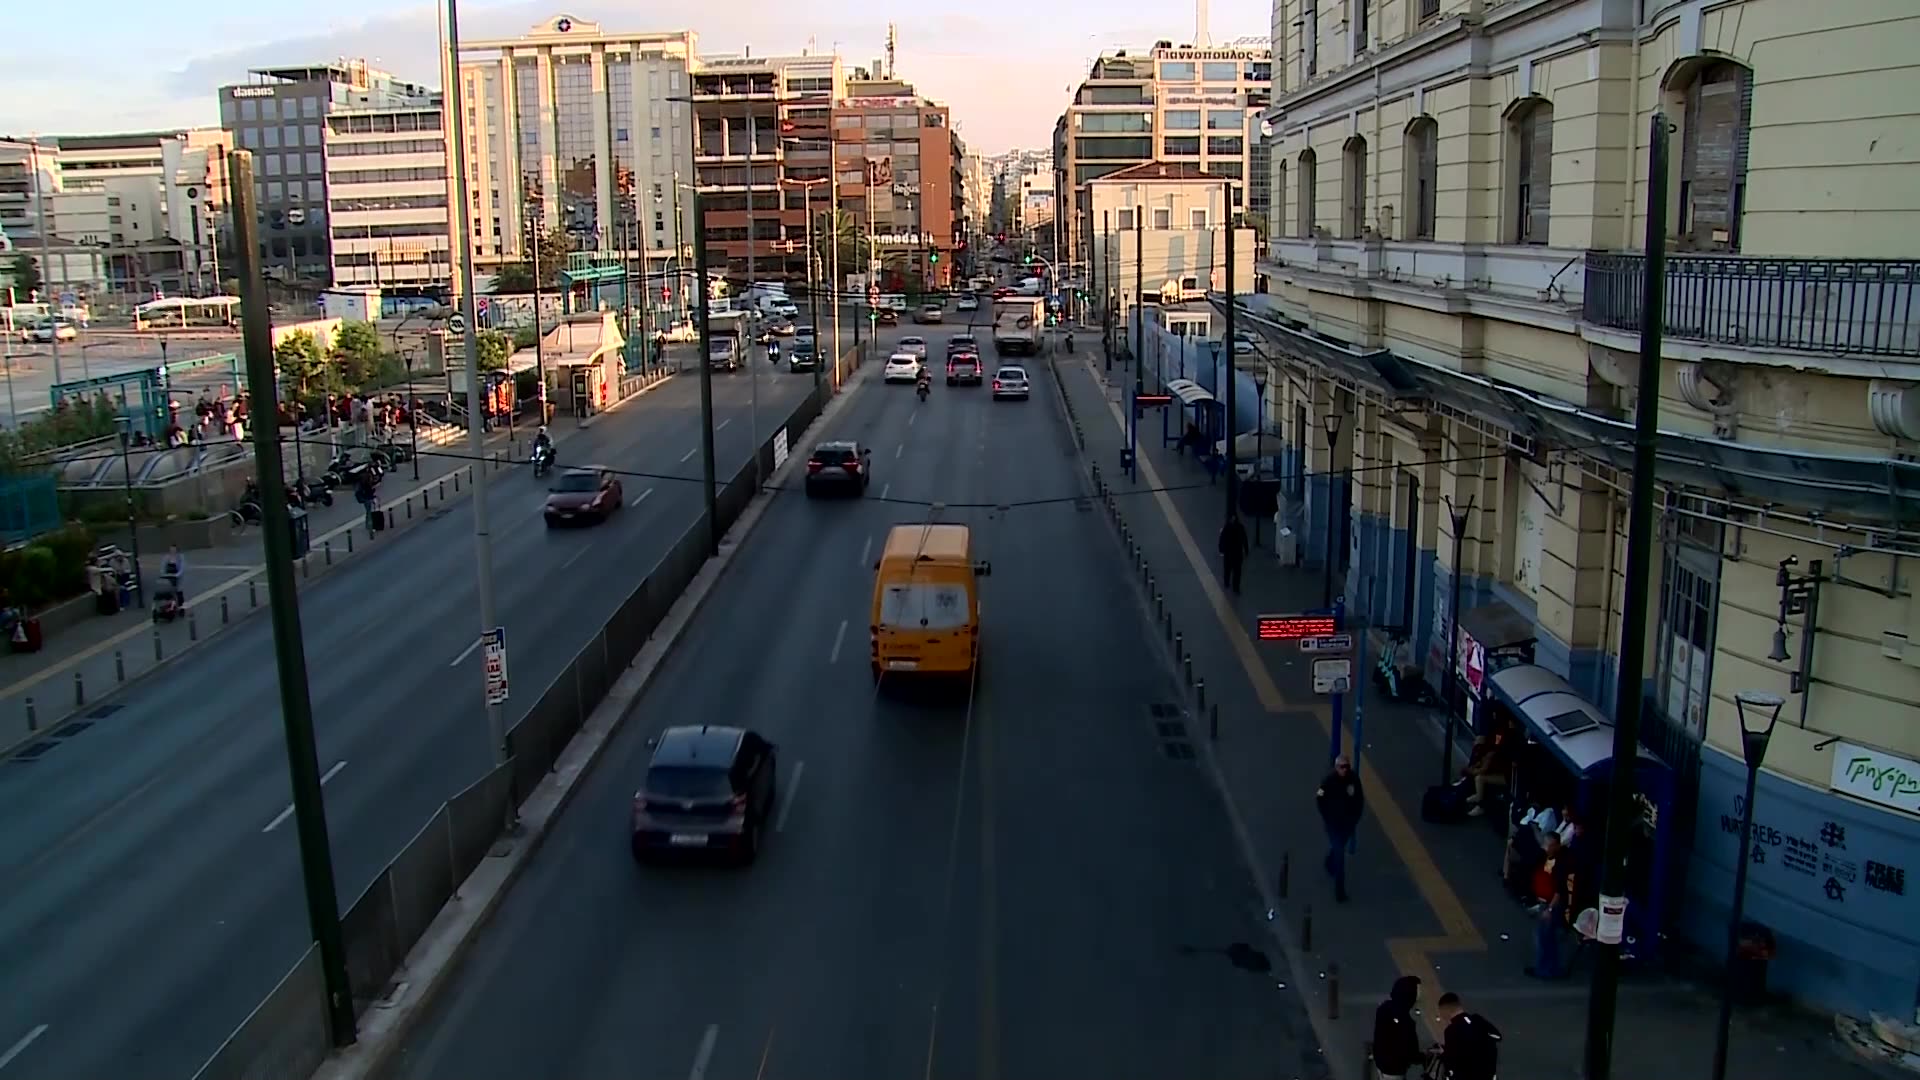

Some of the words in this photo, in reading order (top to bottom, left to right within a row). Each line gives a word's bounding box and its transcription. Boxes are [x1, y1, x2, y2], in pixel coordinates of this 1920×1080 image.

[233, 87, 274, 97] danaos
[894, 182, 919, 196] Regus
[1846, 758, 1920, 798] Γρηγόρη
[1866, 860, 1904, 882] FREE
